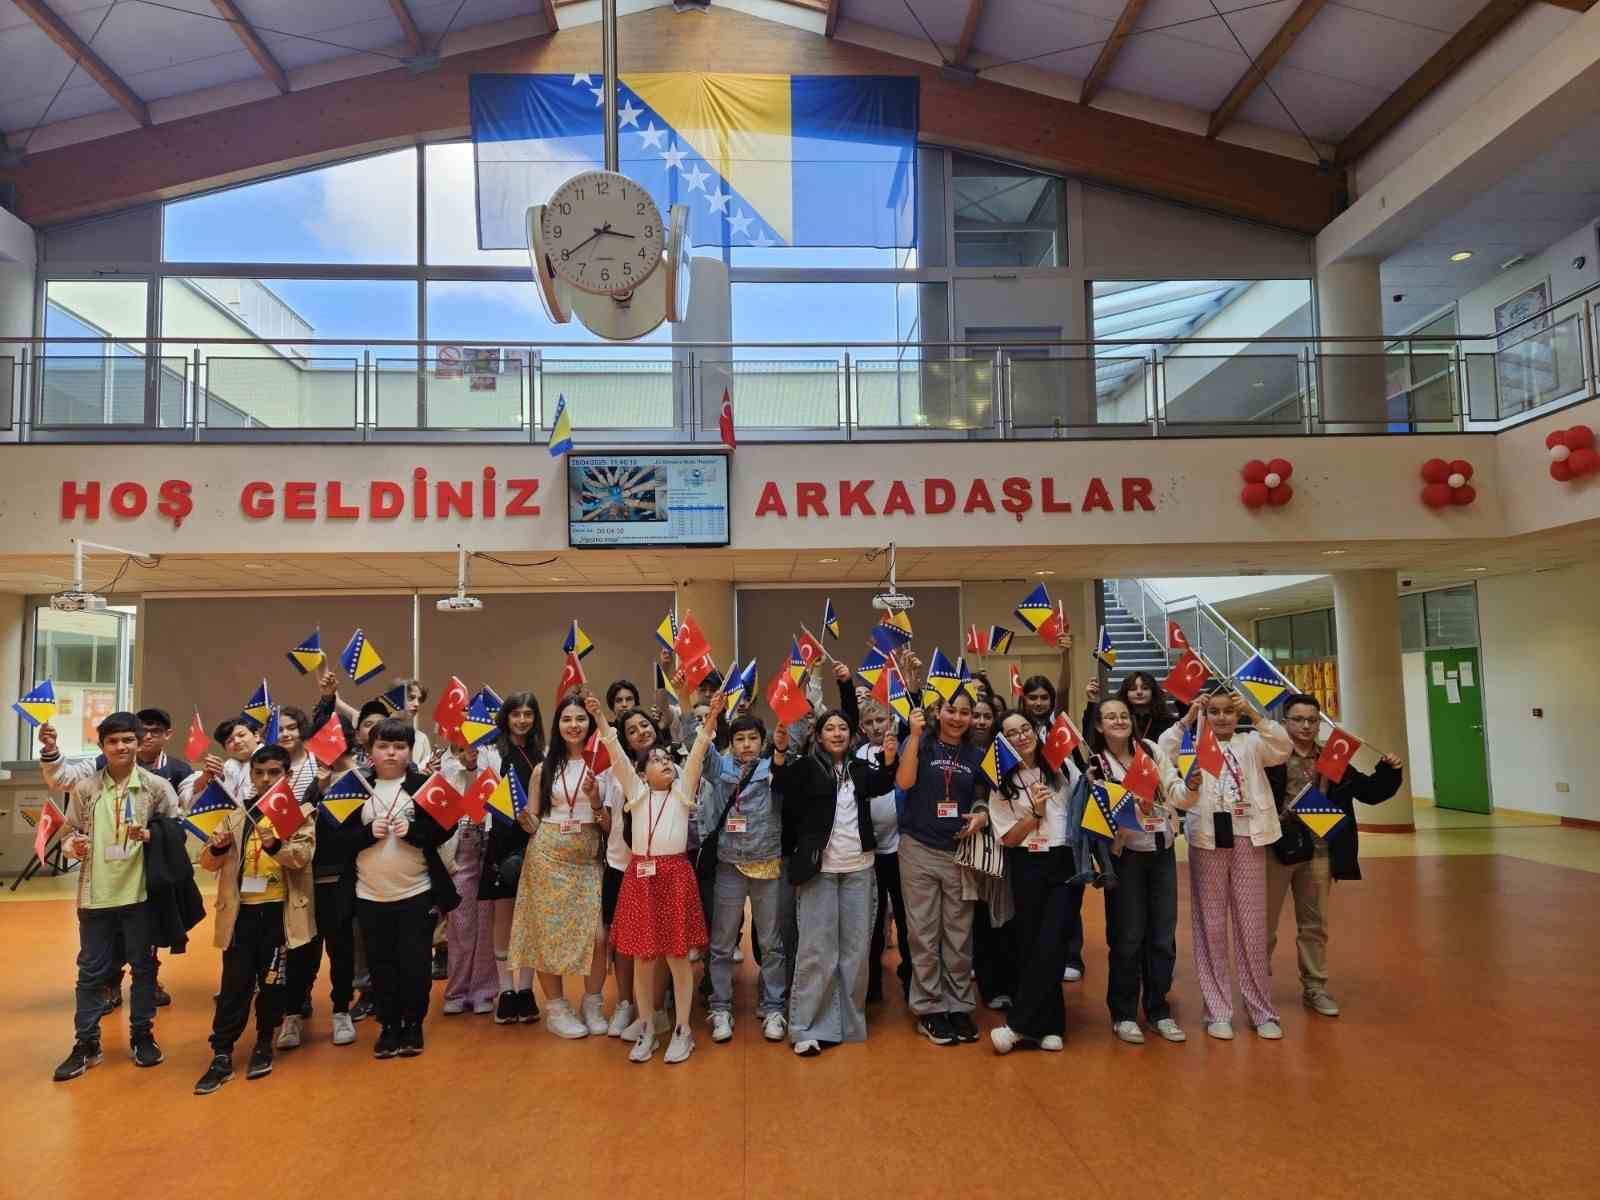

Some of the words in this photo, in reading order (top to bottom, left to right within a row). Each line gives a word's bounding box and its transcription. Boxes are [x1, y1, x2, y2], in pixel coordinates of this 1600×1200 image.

[575, 189, 585, 200] 11
[595, 183, 609, 194] 12
[622, 189, 627, 200] 1
[559, 203, 572, 216] 10
[636, 203, 646, 215] 2
[553, 225, 562, 238] 9
[644, 225, 653, 238] 3
[561, 249, 570, 262] 8
[638, 246, 647, 259] 4
[578, 263, 587, 276] 7
[600, 268, 610, 281] 6
[623, 262, 632, 275] 5
[62, 480, 193, 528] HOŞ
[241, 467, 540, 519] GELDİNİZ
[755, 477, 1156, 522] ARKADAŞLAR
